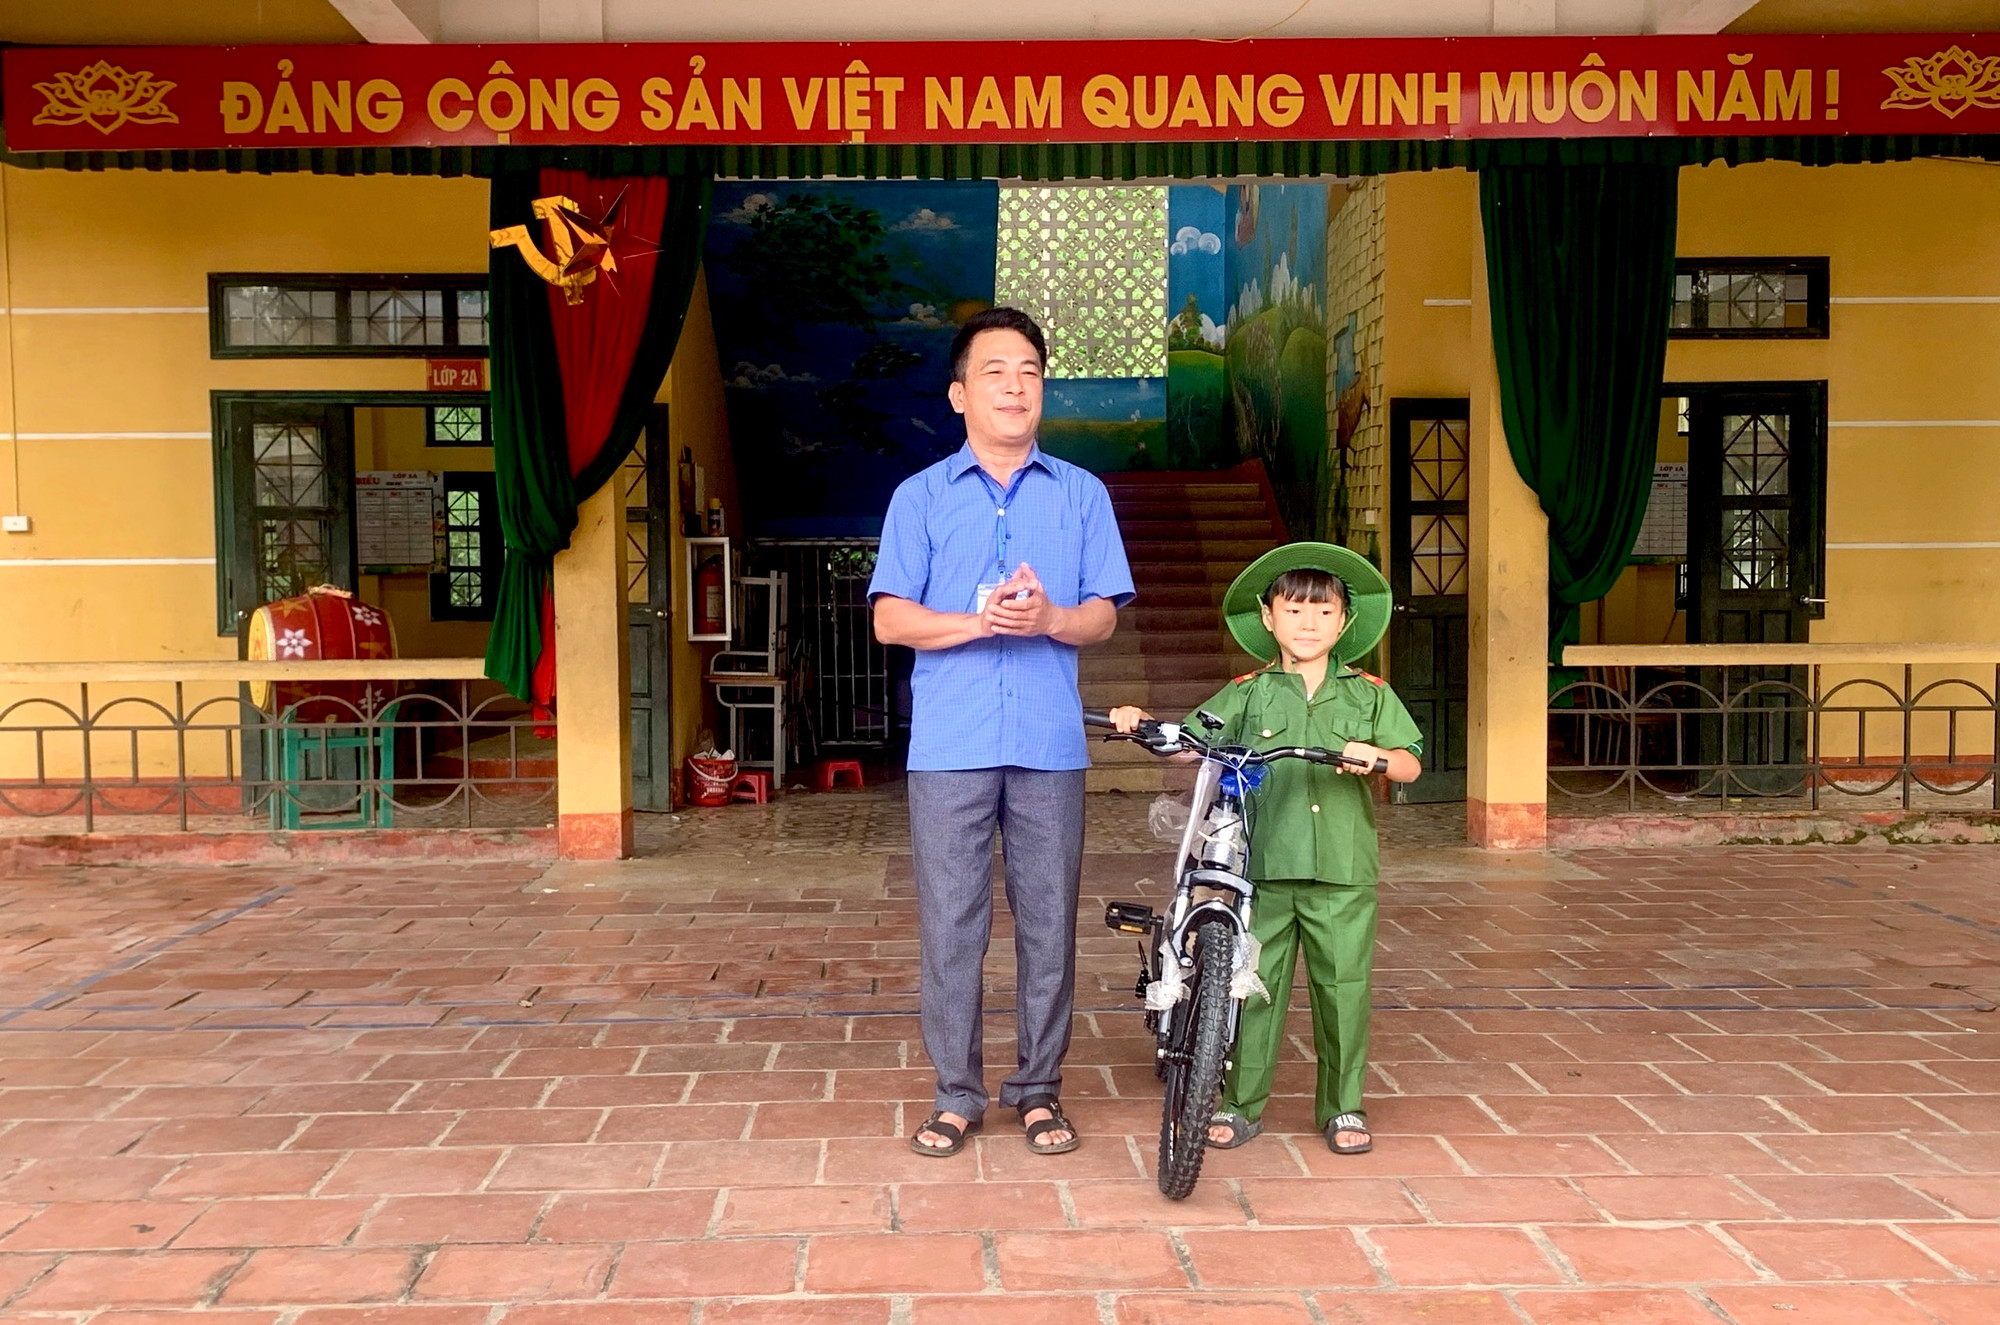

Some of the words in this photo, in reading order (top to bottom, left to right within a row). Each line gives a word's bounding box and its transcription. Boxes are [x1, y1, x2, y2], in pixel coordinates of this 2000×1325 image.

[219, 58, 404, 135] ĐẢNG
[426, 60, 621, 146] CỘNG
[640, 55, 762, 132] SẢN
[782, 59, 905, 146] VIỆT
[925, 75, 1063, 130] NAM
[1081, 73, 1306, 129] QUANG
[1318, 72, 1462, 127] VINH
[1480, 52, 1658, 125] MUÔN
[433, 364, 458, 386] LỚP
[461, 368, 478, 386] 2A
